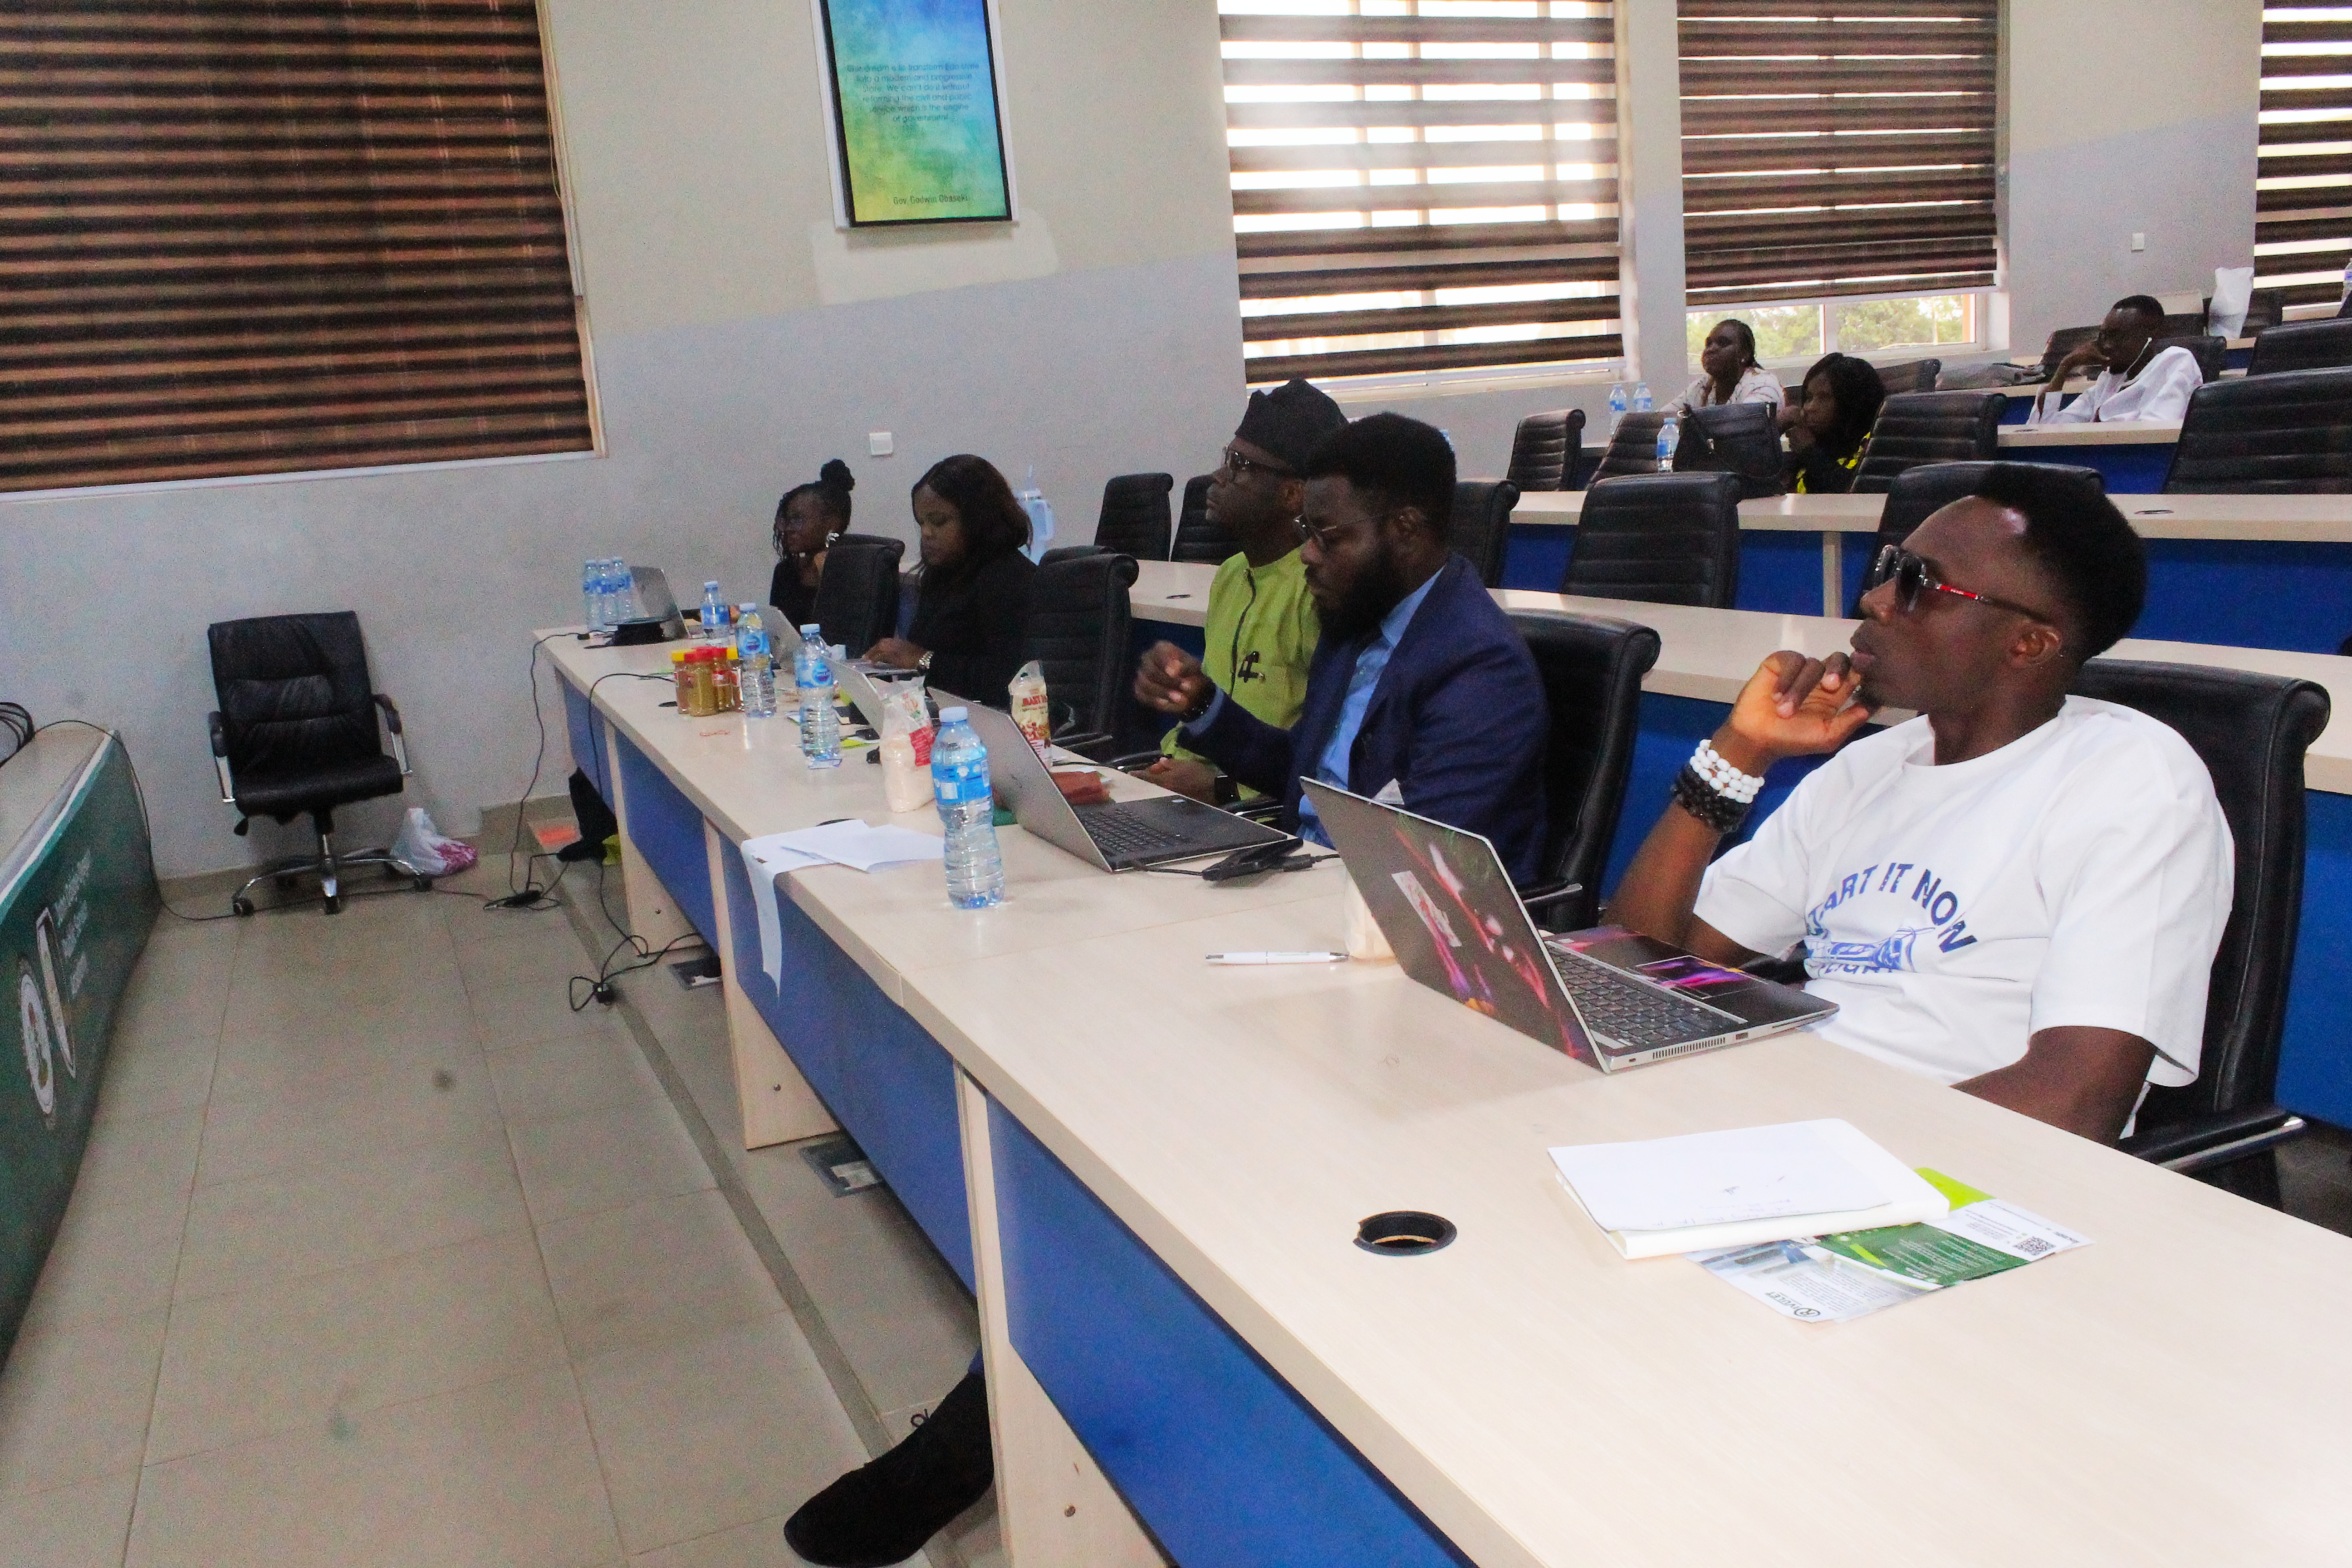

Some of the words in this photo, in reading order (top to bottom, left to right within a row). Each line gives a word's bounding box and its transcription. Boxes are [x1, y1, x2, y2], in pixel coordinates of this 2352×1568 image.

[910, 196, 937, 204] Godwin
[1879, 862, 1914, 893] IT
[1911, 869, 1979, 953] NOW
